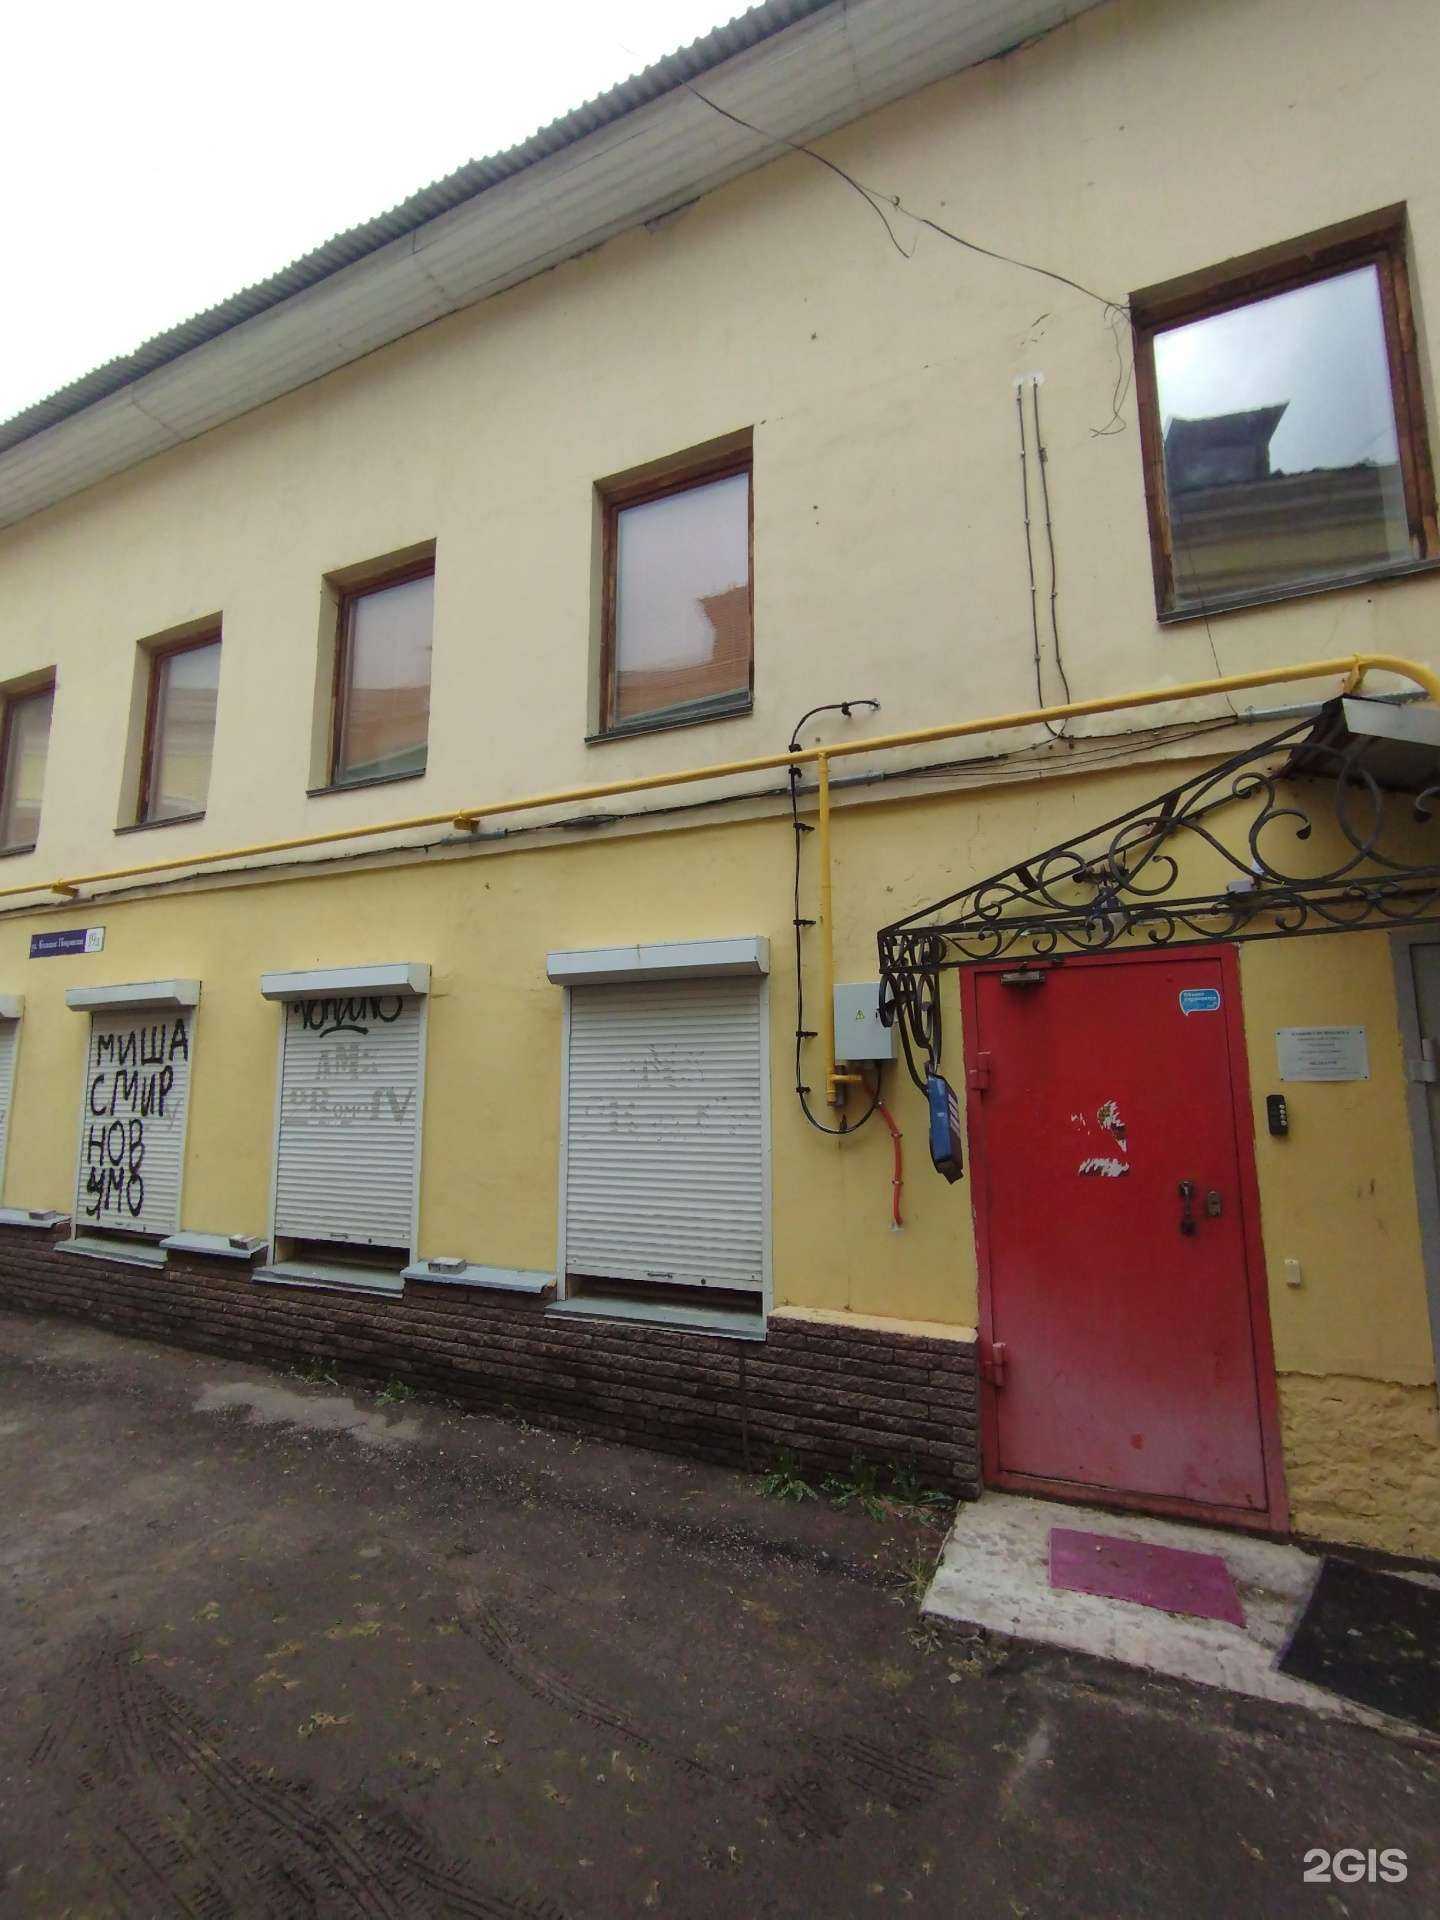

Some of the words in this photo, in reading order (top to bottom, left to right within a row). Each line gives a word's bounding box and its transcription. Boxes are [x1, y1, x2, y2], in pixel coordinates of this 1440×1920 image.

[96, 1018, 189, 1066] МИША
[90, 1065, 174, 1117] СМИР
[87, 1119, 145, 1173] НОВ
